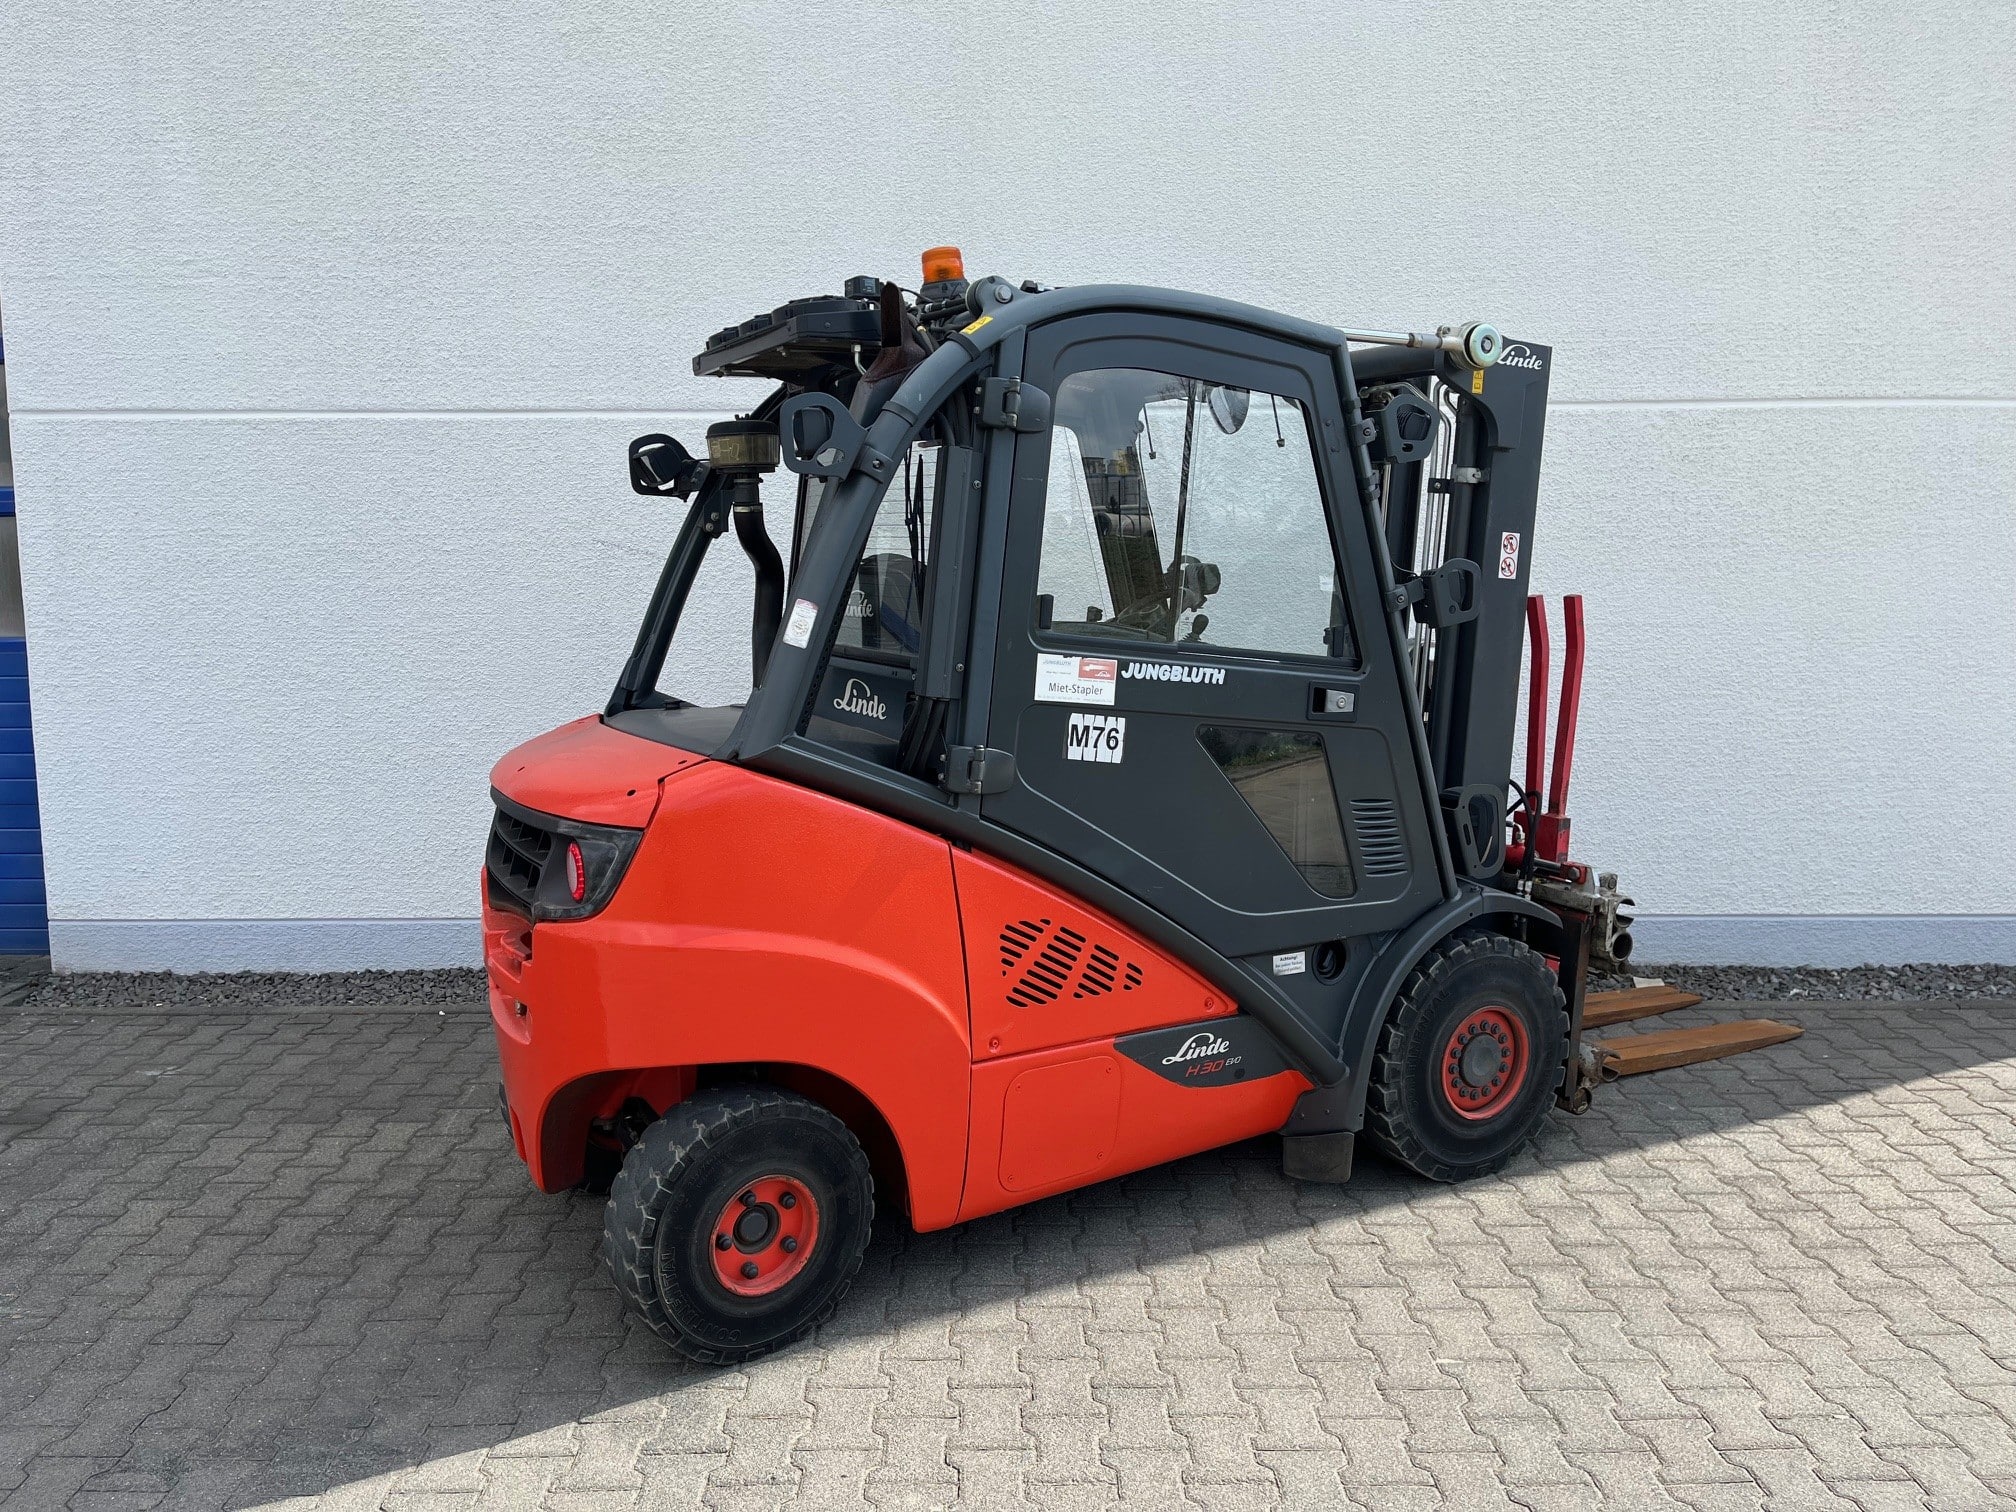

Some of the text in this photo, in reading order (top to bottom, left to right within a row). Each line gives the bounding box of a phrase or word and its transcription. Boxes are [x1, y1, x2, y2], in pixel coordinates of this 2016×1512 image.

[1497, 344, 1543, 370] Linde
[1121, 662, 1226, 685] JUNGBLUTH
[833, 678, 887, 720] Linde
[1048, 682, 1104, 696] Miet-Stapler
[1069, 723, 1120, 751] M76
[1162, 1032, 1230, 1065] Linde
[1185, 1059, 1225, 1078] H30
